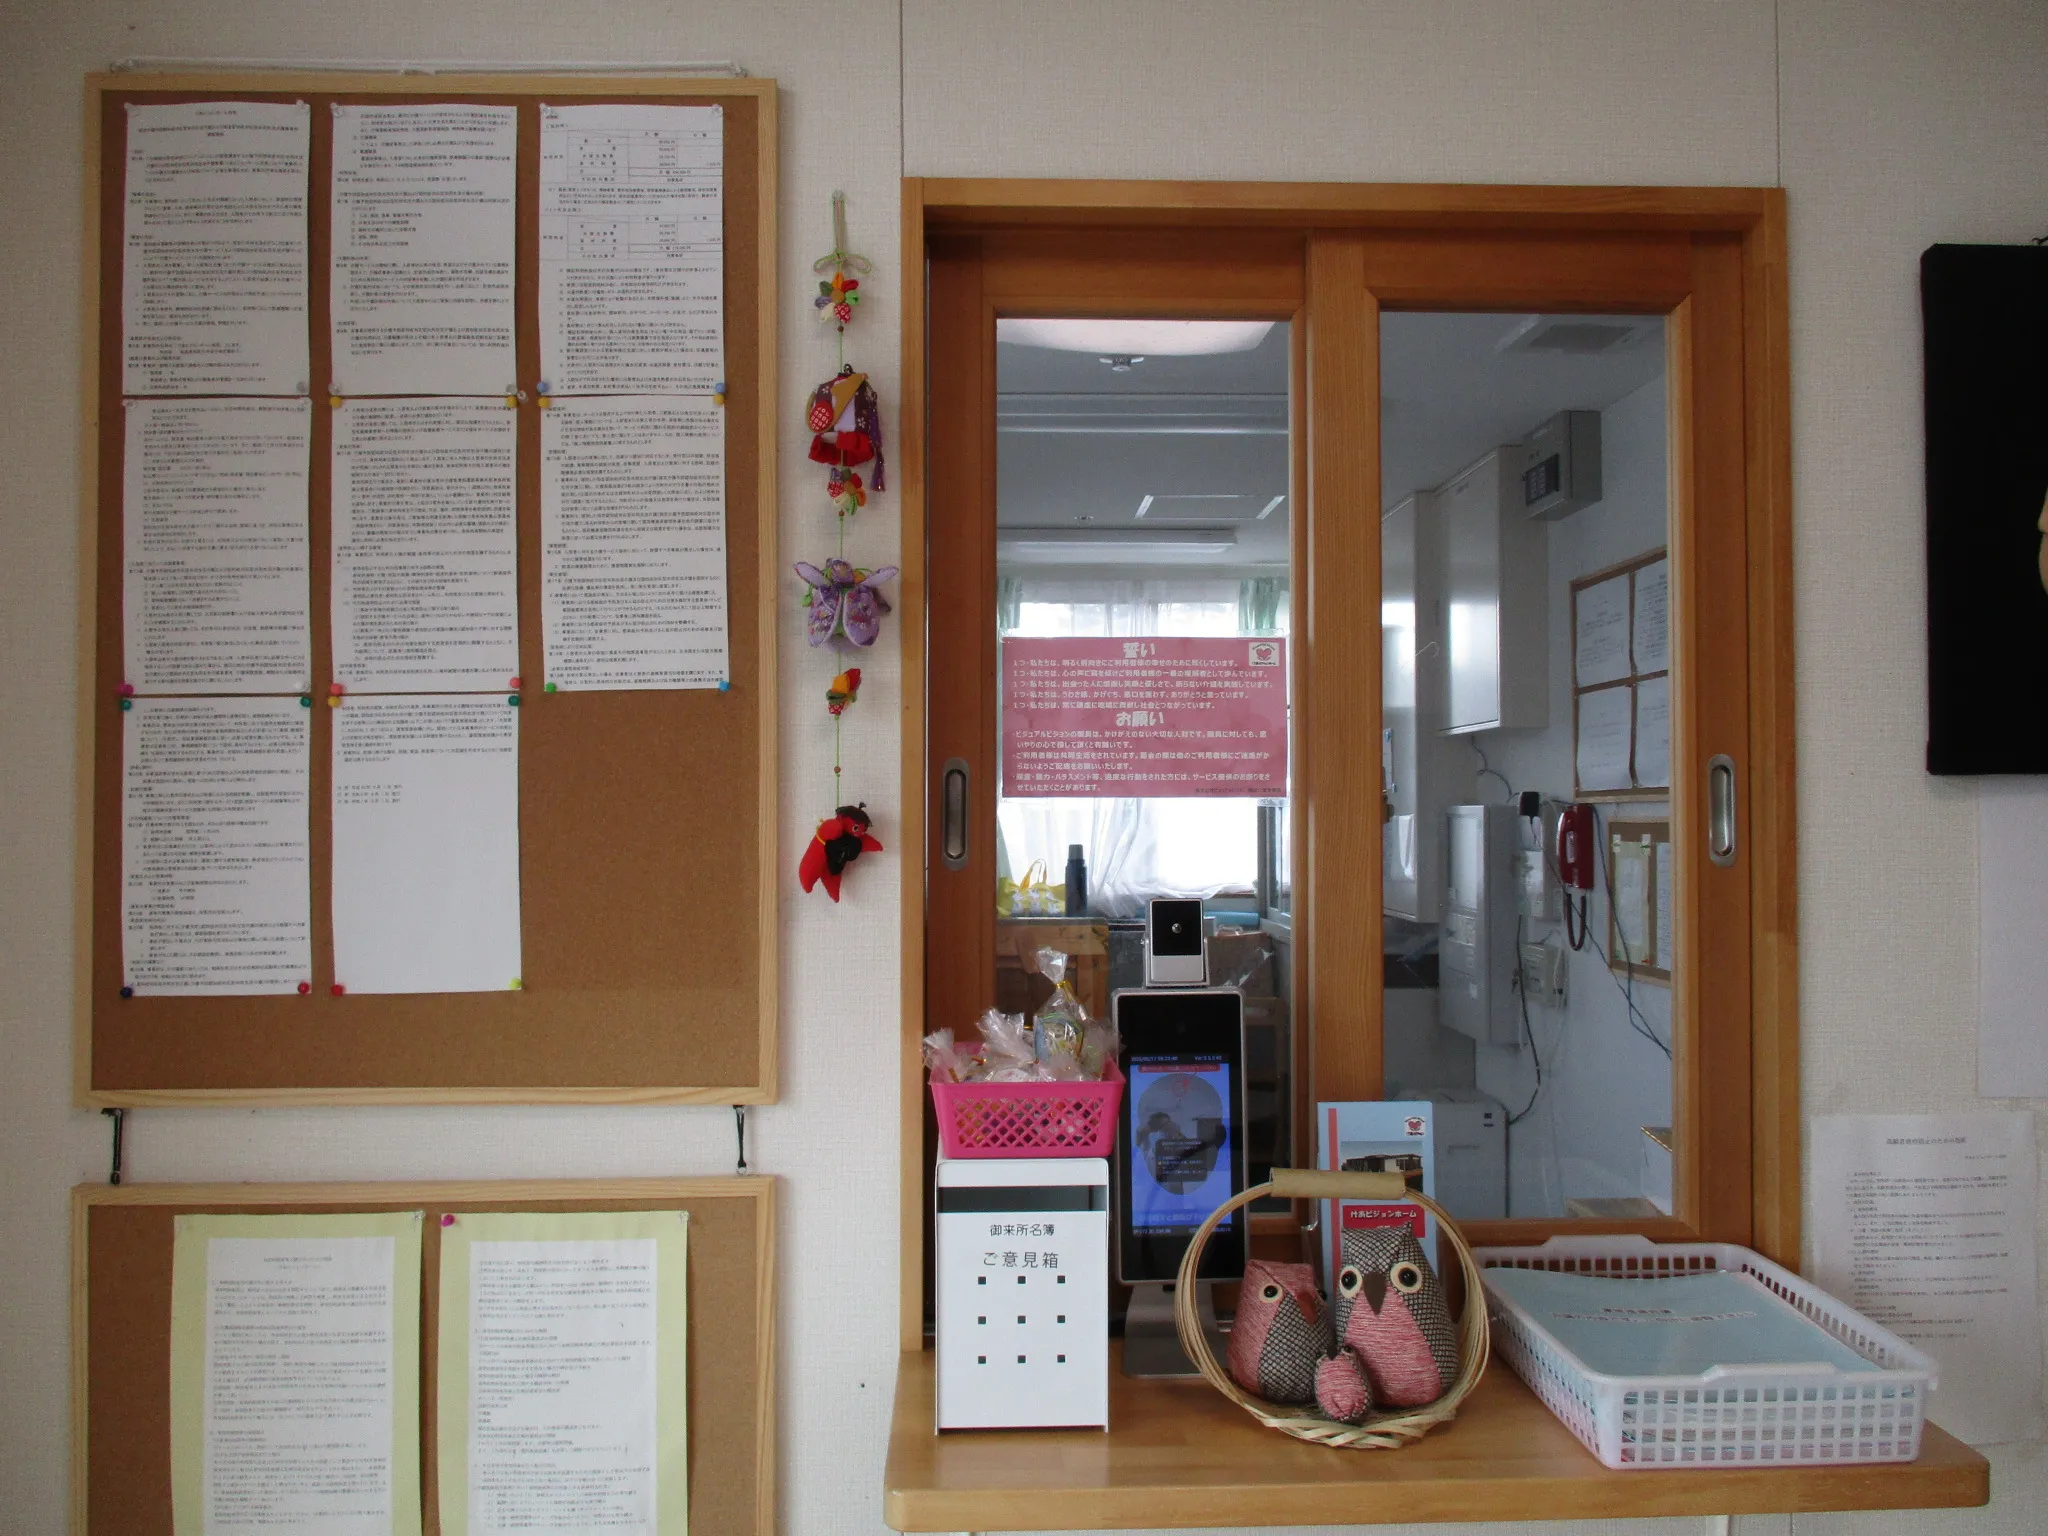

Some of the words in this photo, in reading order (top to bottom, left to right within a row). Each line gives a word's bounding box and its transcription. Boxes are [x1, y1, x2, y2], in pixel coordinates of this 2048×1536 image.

[1123, 642, 1156, 658] 誓い
[1115, 710, 1165, 728] お願い
[990, 1224, 1055, 1236] 御来所名簿
[983, 1252, 1060, 1269] ご意見箱
